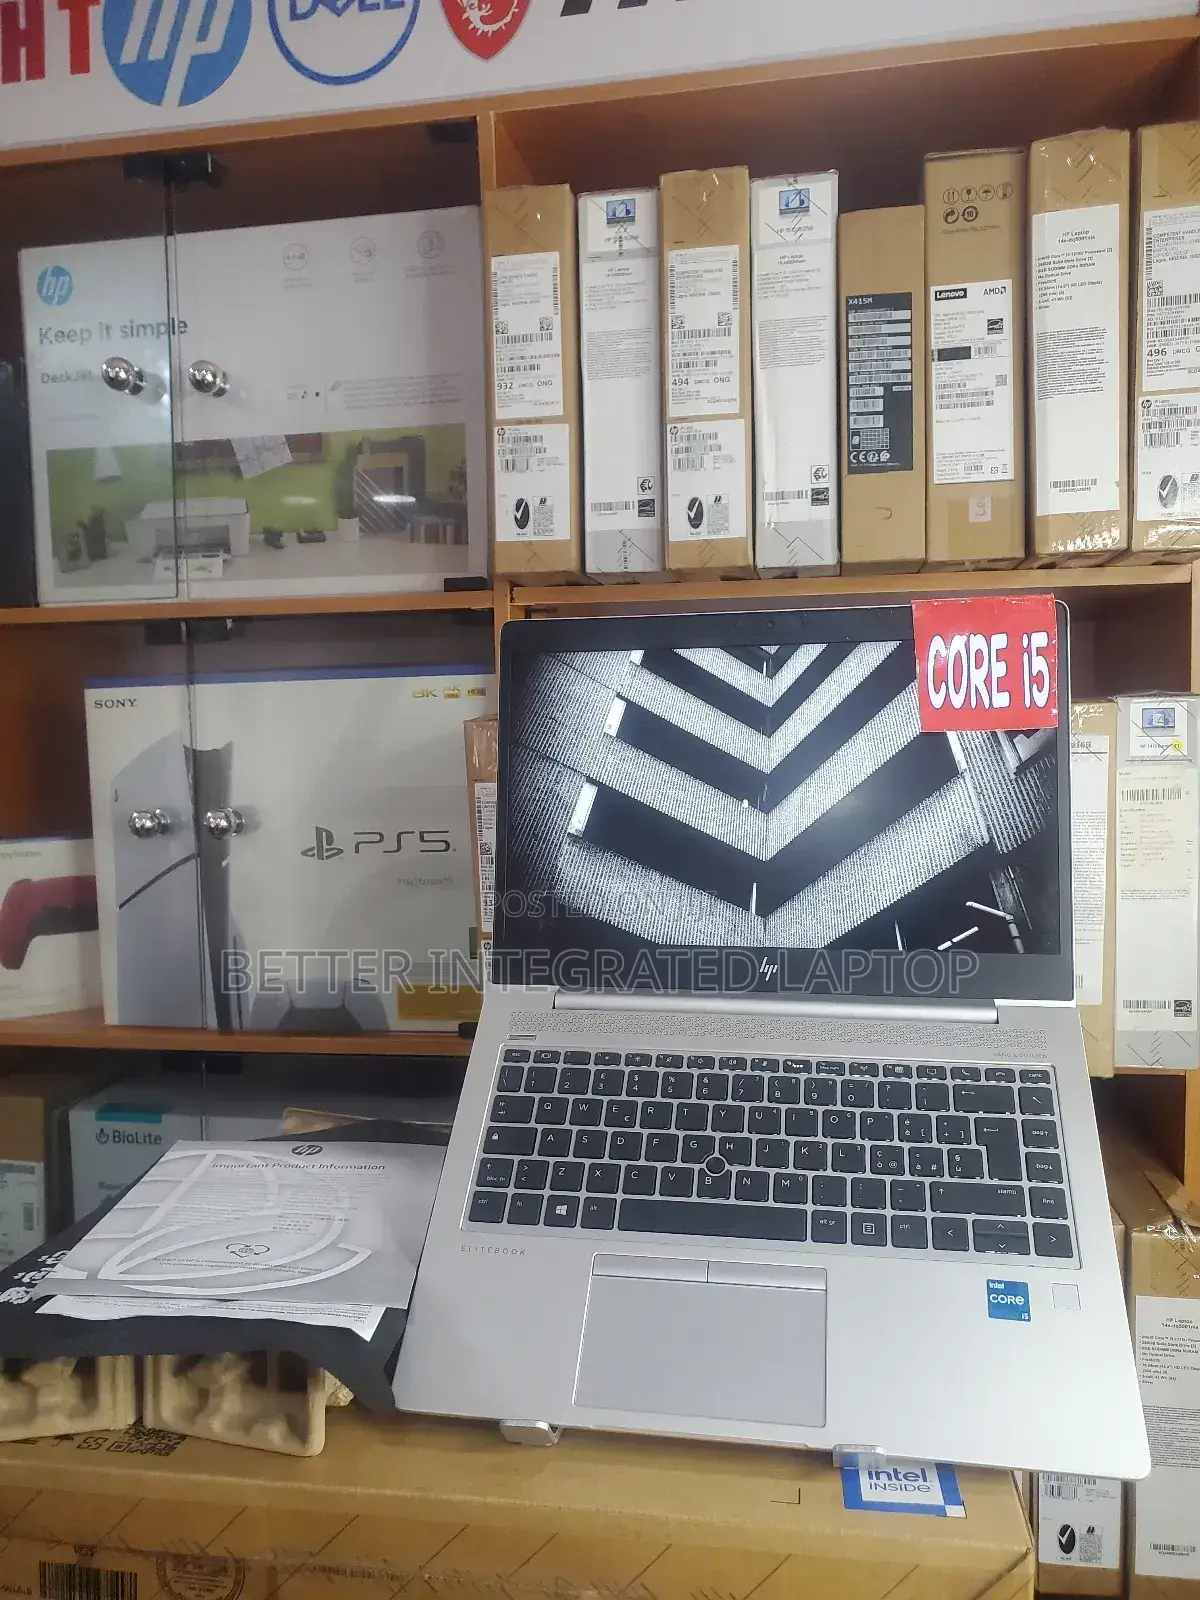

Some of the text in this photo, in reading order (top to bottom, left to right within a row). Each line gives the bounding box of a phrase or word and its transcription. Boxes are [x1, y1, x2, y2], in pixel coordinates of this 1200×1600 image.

[1071, 229, 1090, 237] Laptop
[41, 266, 70, 306] hp
[983, 287, 1000, 296] AMD
[936, 289, 965, 299] Lenovo
[39, 316, 188, 345] Keep it simple
[1147, 348, 1167, 358] 496
[496, 382, 514, 391] 932
[537, 379, 553, 387] ONG
[671, 377, 689, 387] 494
[713, 376, 731, 384] ONG
[927, 631, 1050, 710] CORE i5
[412, 688, 439, 699] 8K
[93, 697, 138, 710] SONY
[353, 830, 452, 854] PS5
[759, 956, 778, 981] hp
[112, 1129, 163, 1145] BioLite
[212, 1162, 386, 1171] Important Product Information
[461, 1245, 526, 1256] ELITEBOOK
[989, 1281, 1005, 1290] intel
[1021, 1312, 1029, 1321] i5
[867, 1466, 929, 1483] intel
